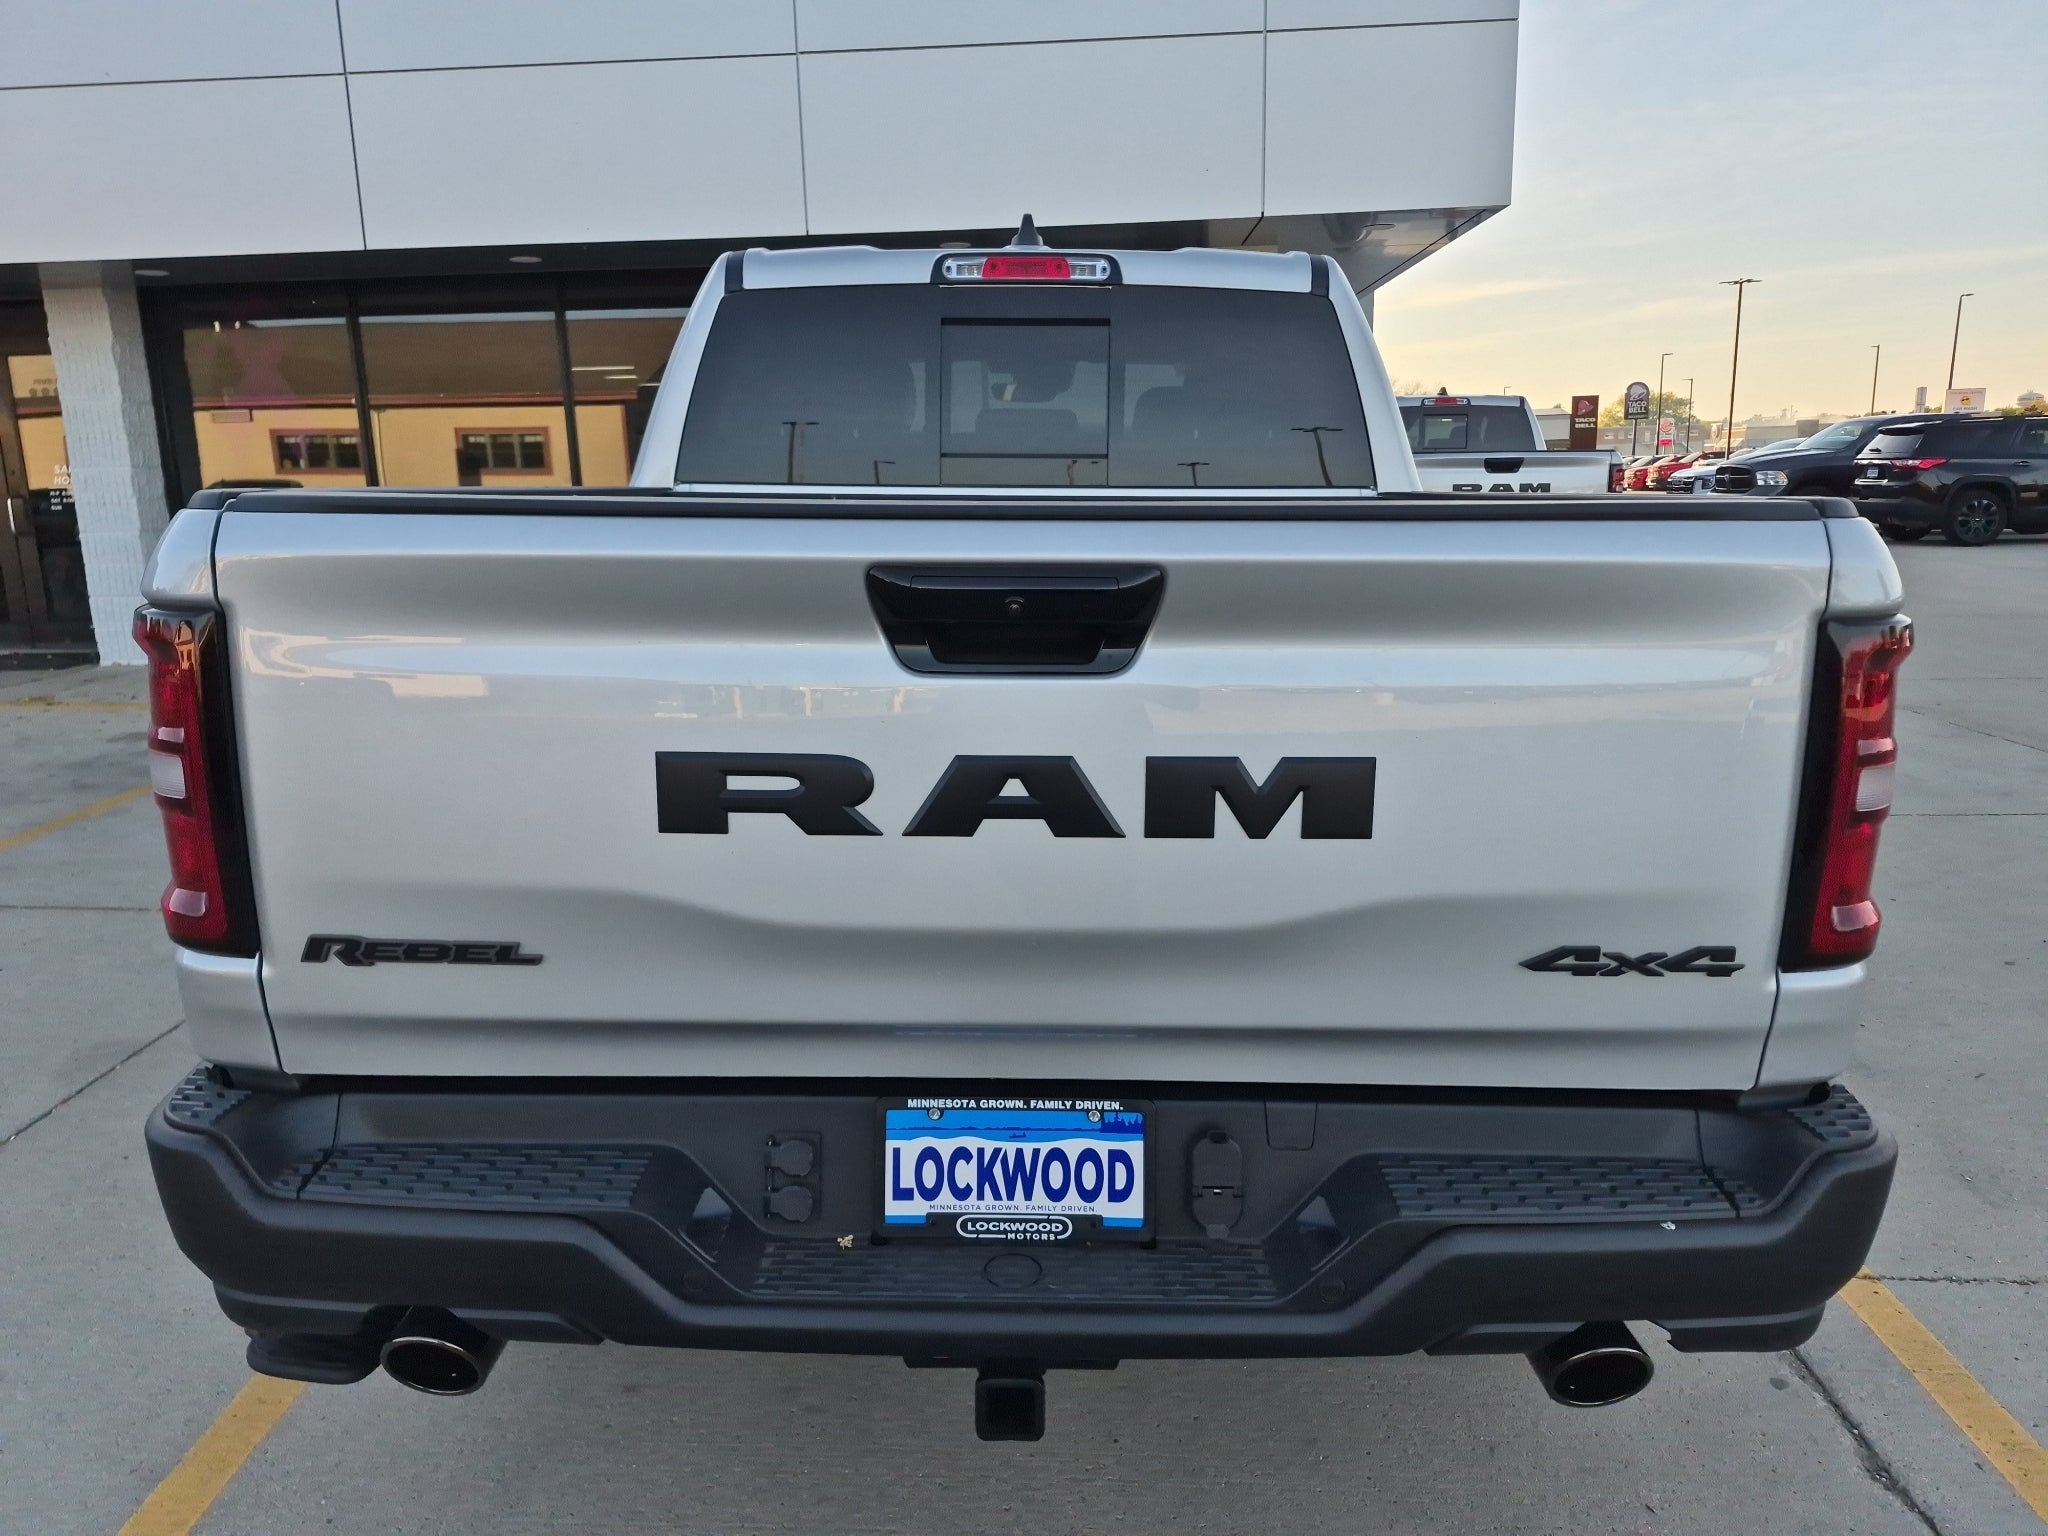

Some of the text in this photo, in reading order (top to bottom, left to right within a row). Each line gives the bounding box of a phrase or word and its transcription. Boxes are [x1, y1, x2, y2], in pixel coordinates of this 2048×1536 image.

[1452, 483, 1551, 493] RAM
[655, 751, 1377, 840] RAM
[301, 934, 544, 966] REBEL
[1518, 945, 1746, 977] 4x4
[907, 1098, 1124, 1110] MINNESOTA GROWN. FAMILY DRIVEN.
[892, 1146, 1135, 1203] LOCKWOOD
[984, 1204, 1022, 1212] GROWN.
[1025, 1204, 1057, 1212] FAMILY
[967, 1221, 1063, 1232] LOCKWOOD
[1007, 1232, 1055, 1240] MOTORS
